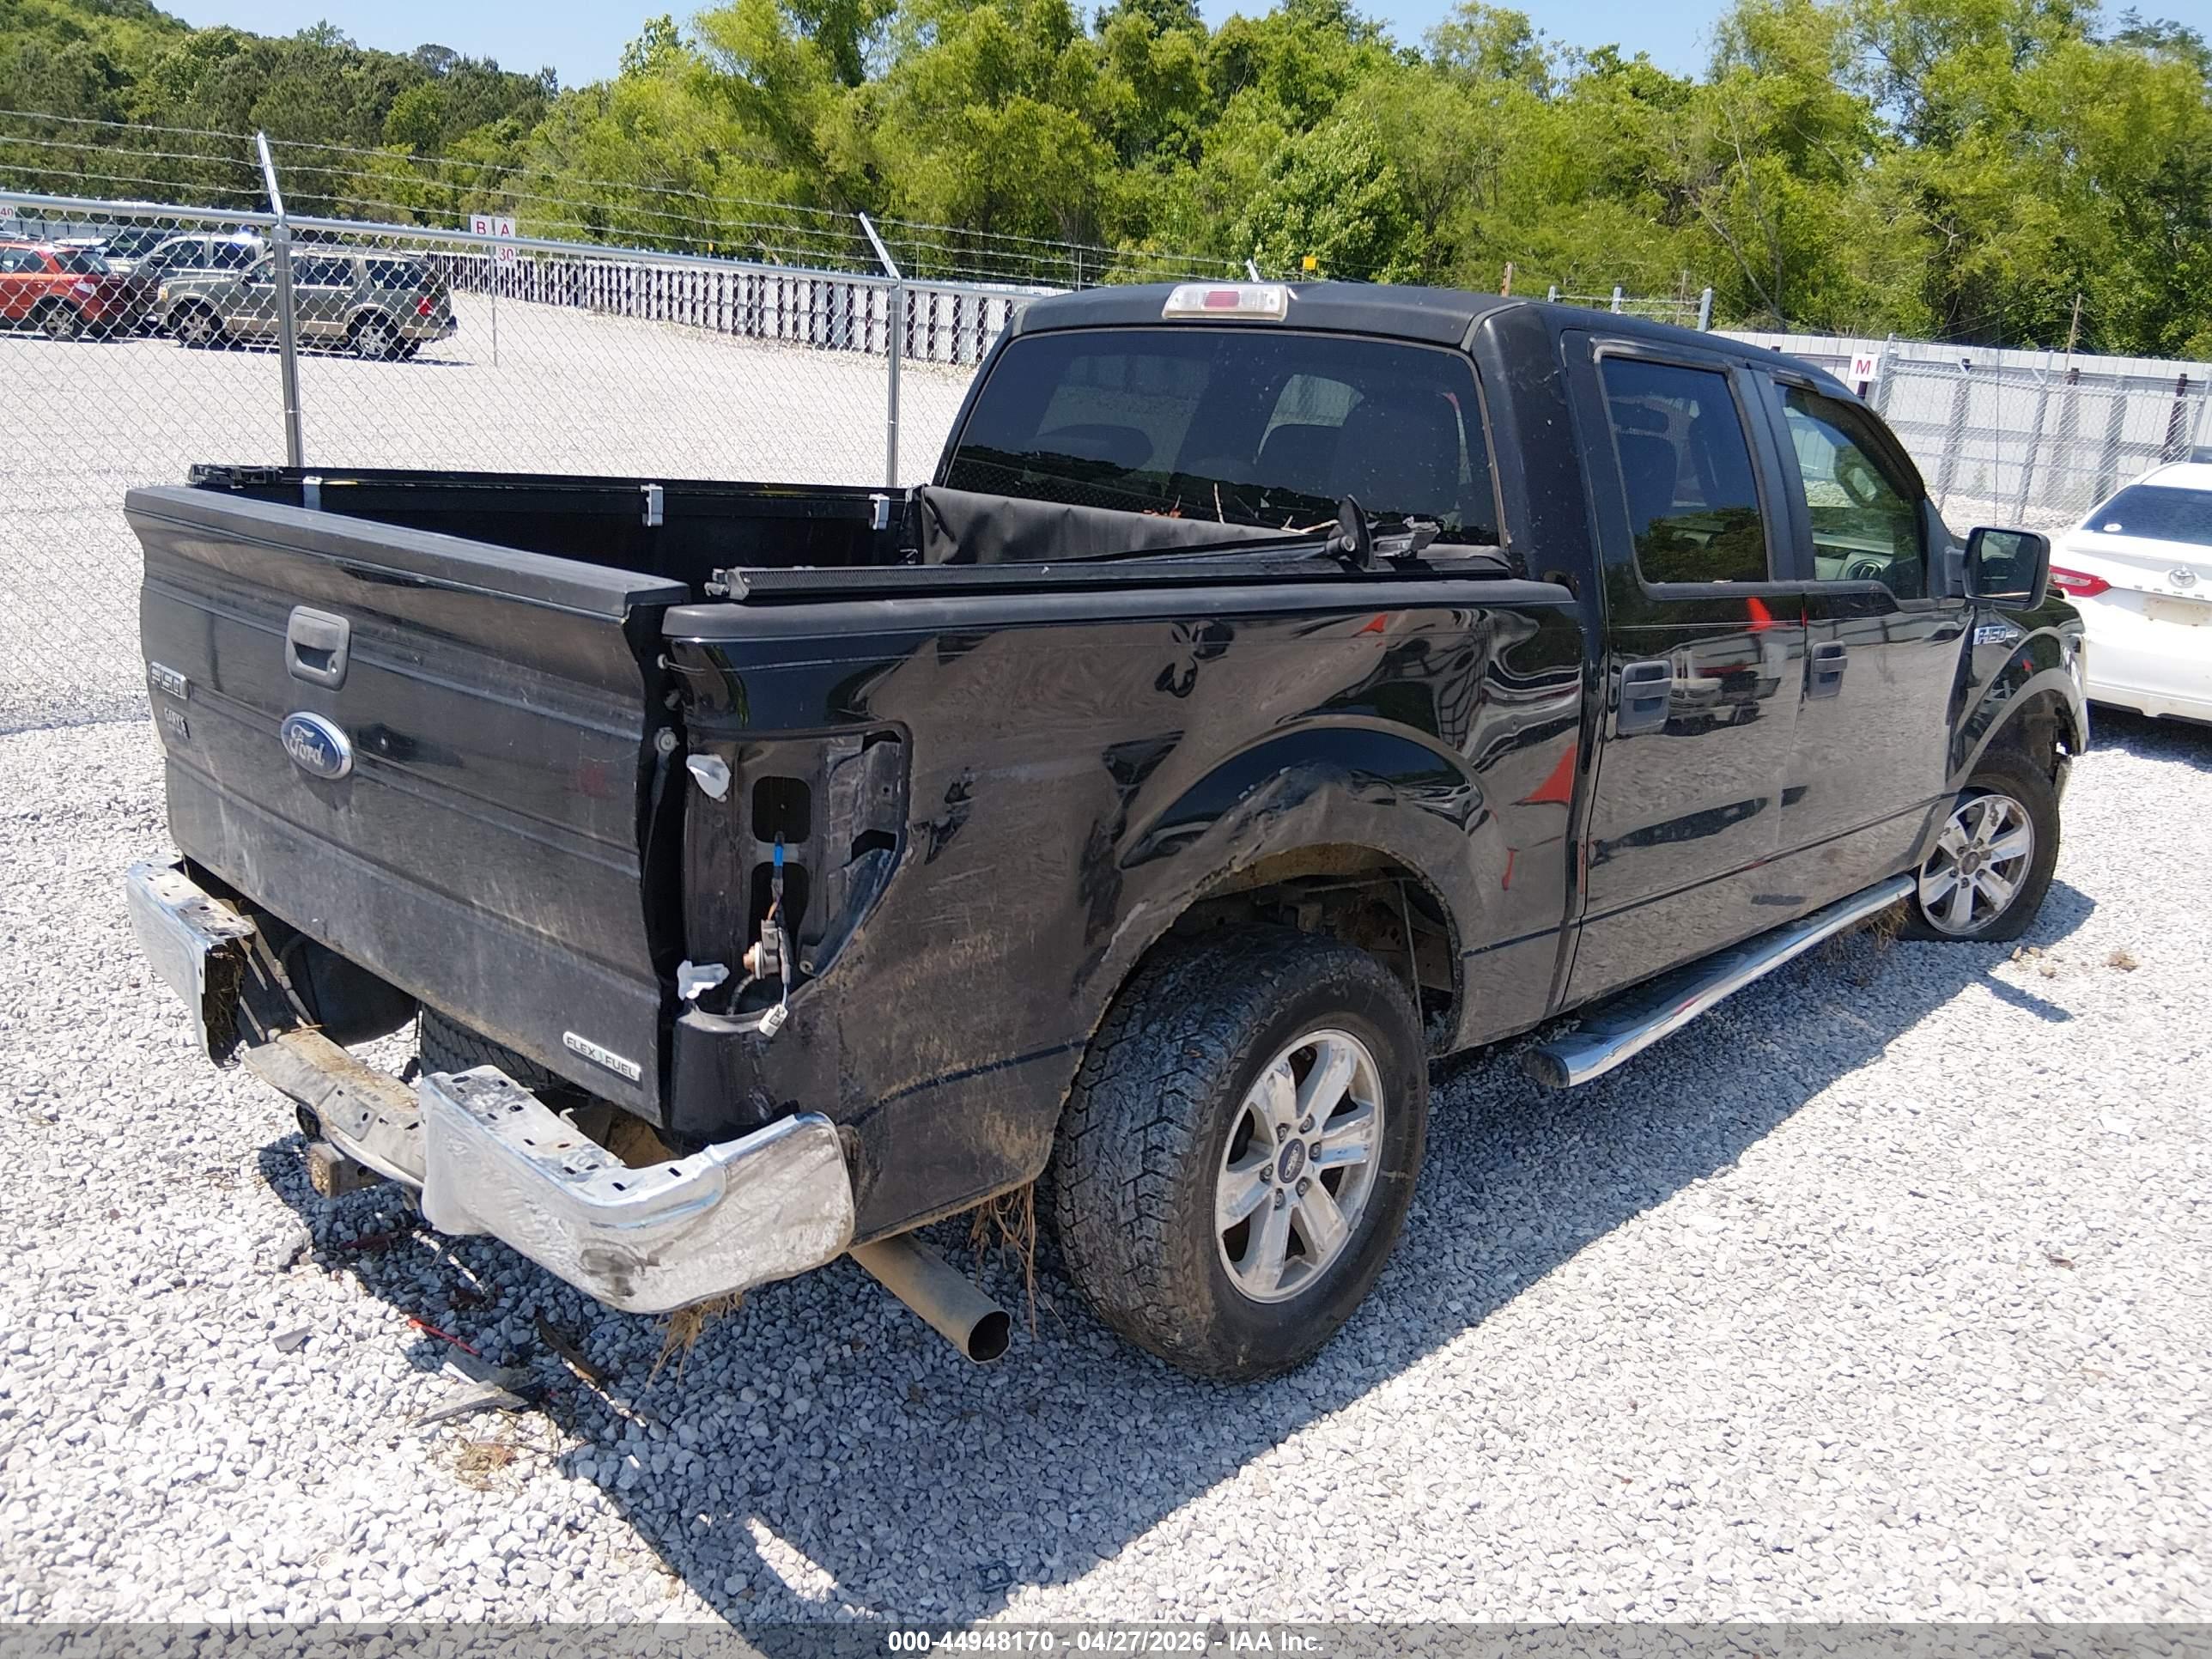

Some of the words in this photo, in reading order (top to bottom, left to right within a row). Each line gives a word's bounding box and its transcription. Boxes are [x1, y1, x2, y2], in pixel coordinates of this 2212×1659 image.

[476, 221, 487, 235] B
[501, 222, 512, 237] A
[499, 248, 514, 262] 30
[1856, 359, 1871, 375] M
[289, 724, 325, 766] Ford
[567, 1036, 596, 1059] FLEX
[605, 1055, 636, 1079] FUEL
